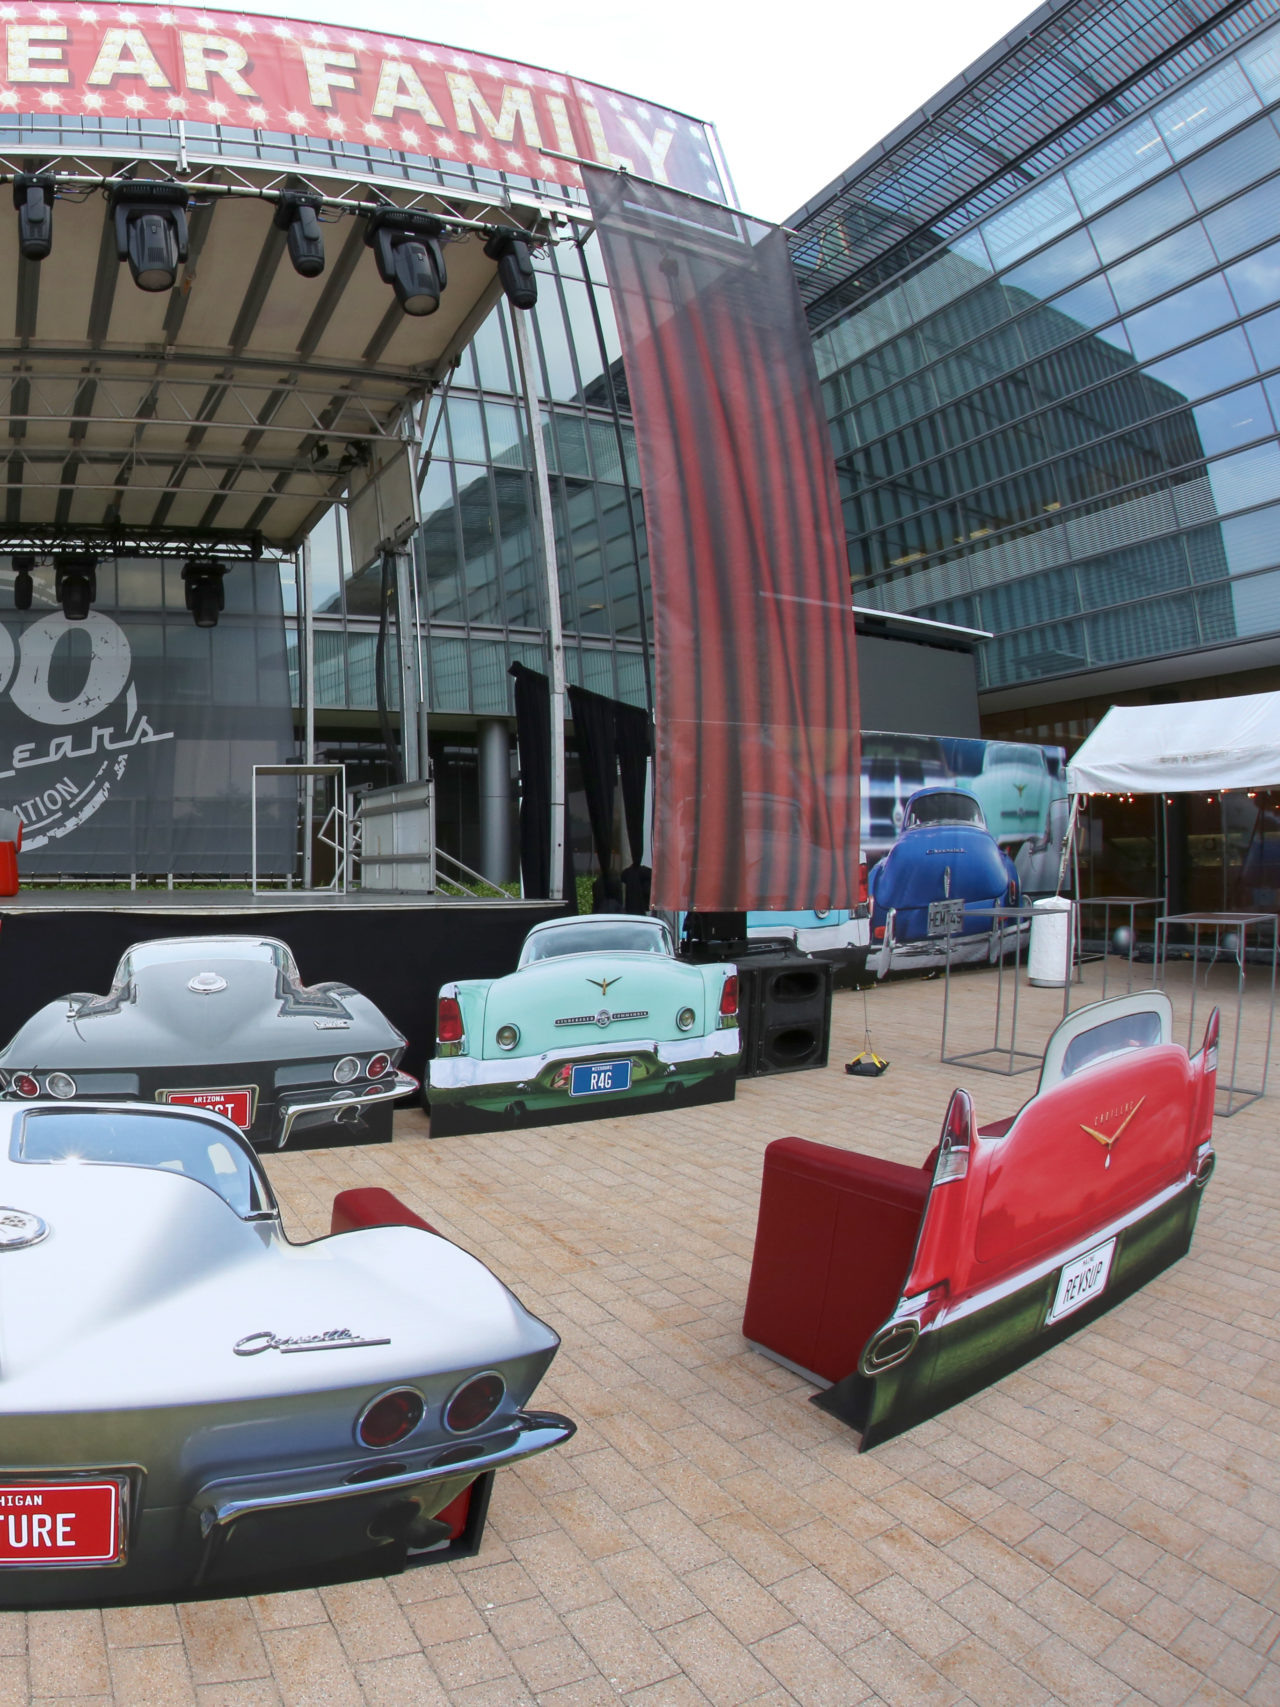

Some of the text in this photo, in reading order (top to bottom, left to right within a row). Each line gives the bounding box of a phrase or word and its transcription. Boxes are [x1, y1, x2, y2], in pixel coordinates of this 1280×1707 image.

[300, 45, 673, 184] FAMILY
[590, 1071, 613, 1090] R4G
[193, 1094, 225, 1103] ARIZONA
[1062, 1261, 1103, 1304] REVSUP
